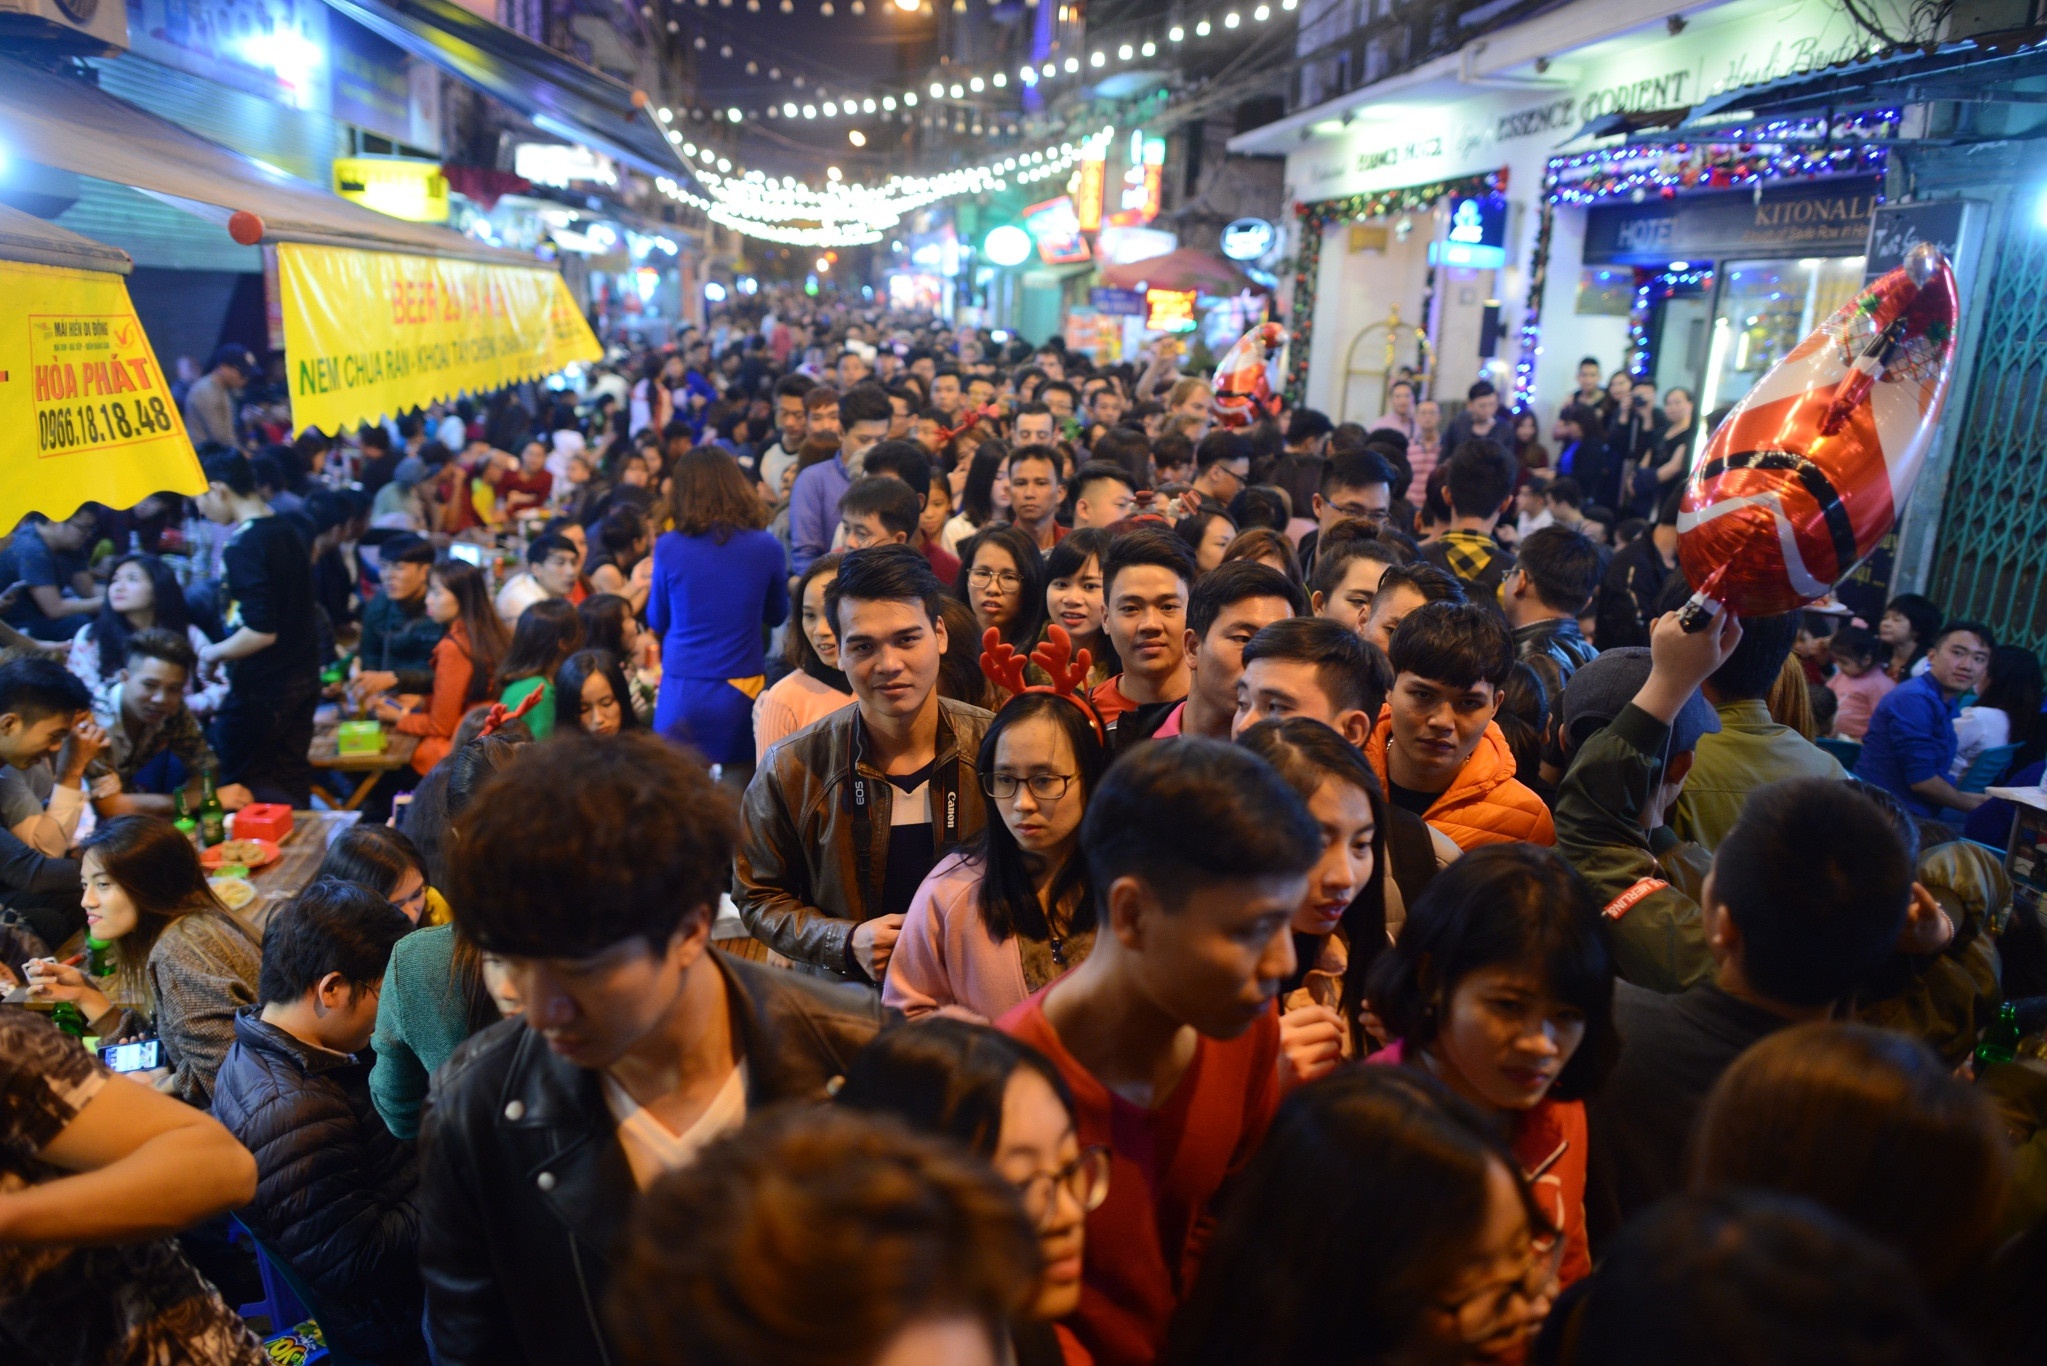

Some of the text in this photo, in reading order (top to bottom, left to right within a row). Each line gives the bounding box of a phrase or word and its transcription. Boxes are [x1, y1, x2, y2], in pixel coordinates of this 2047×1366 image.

[35, 352, 152, 402] HÒA PHÁT
[299, 356, 341, 397] NEM
[38, 395, 172, 452] 0966.18.18.48
[855, 781, 865, 806] EOS
[947, 791, 957, 828] Canon
